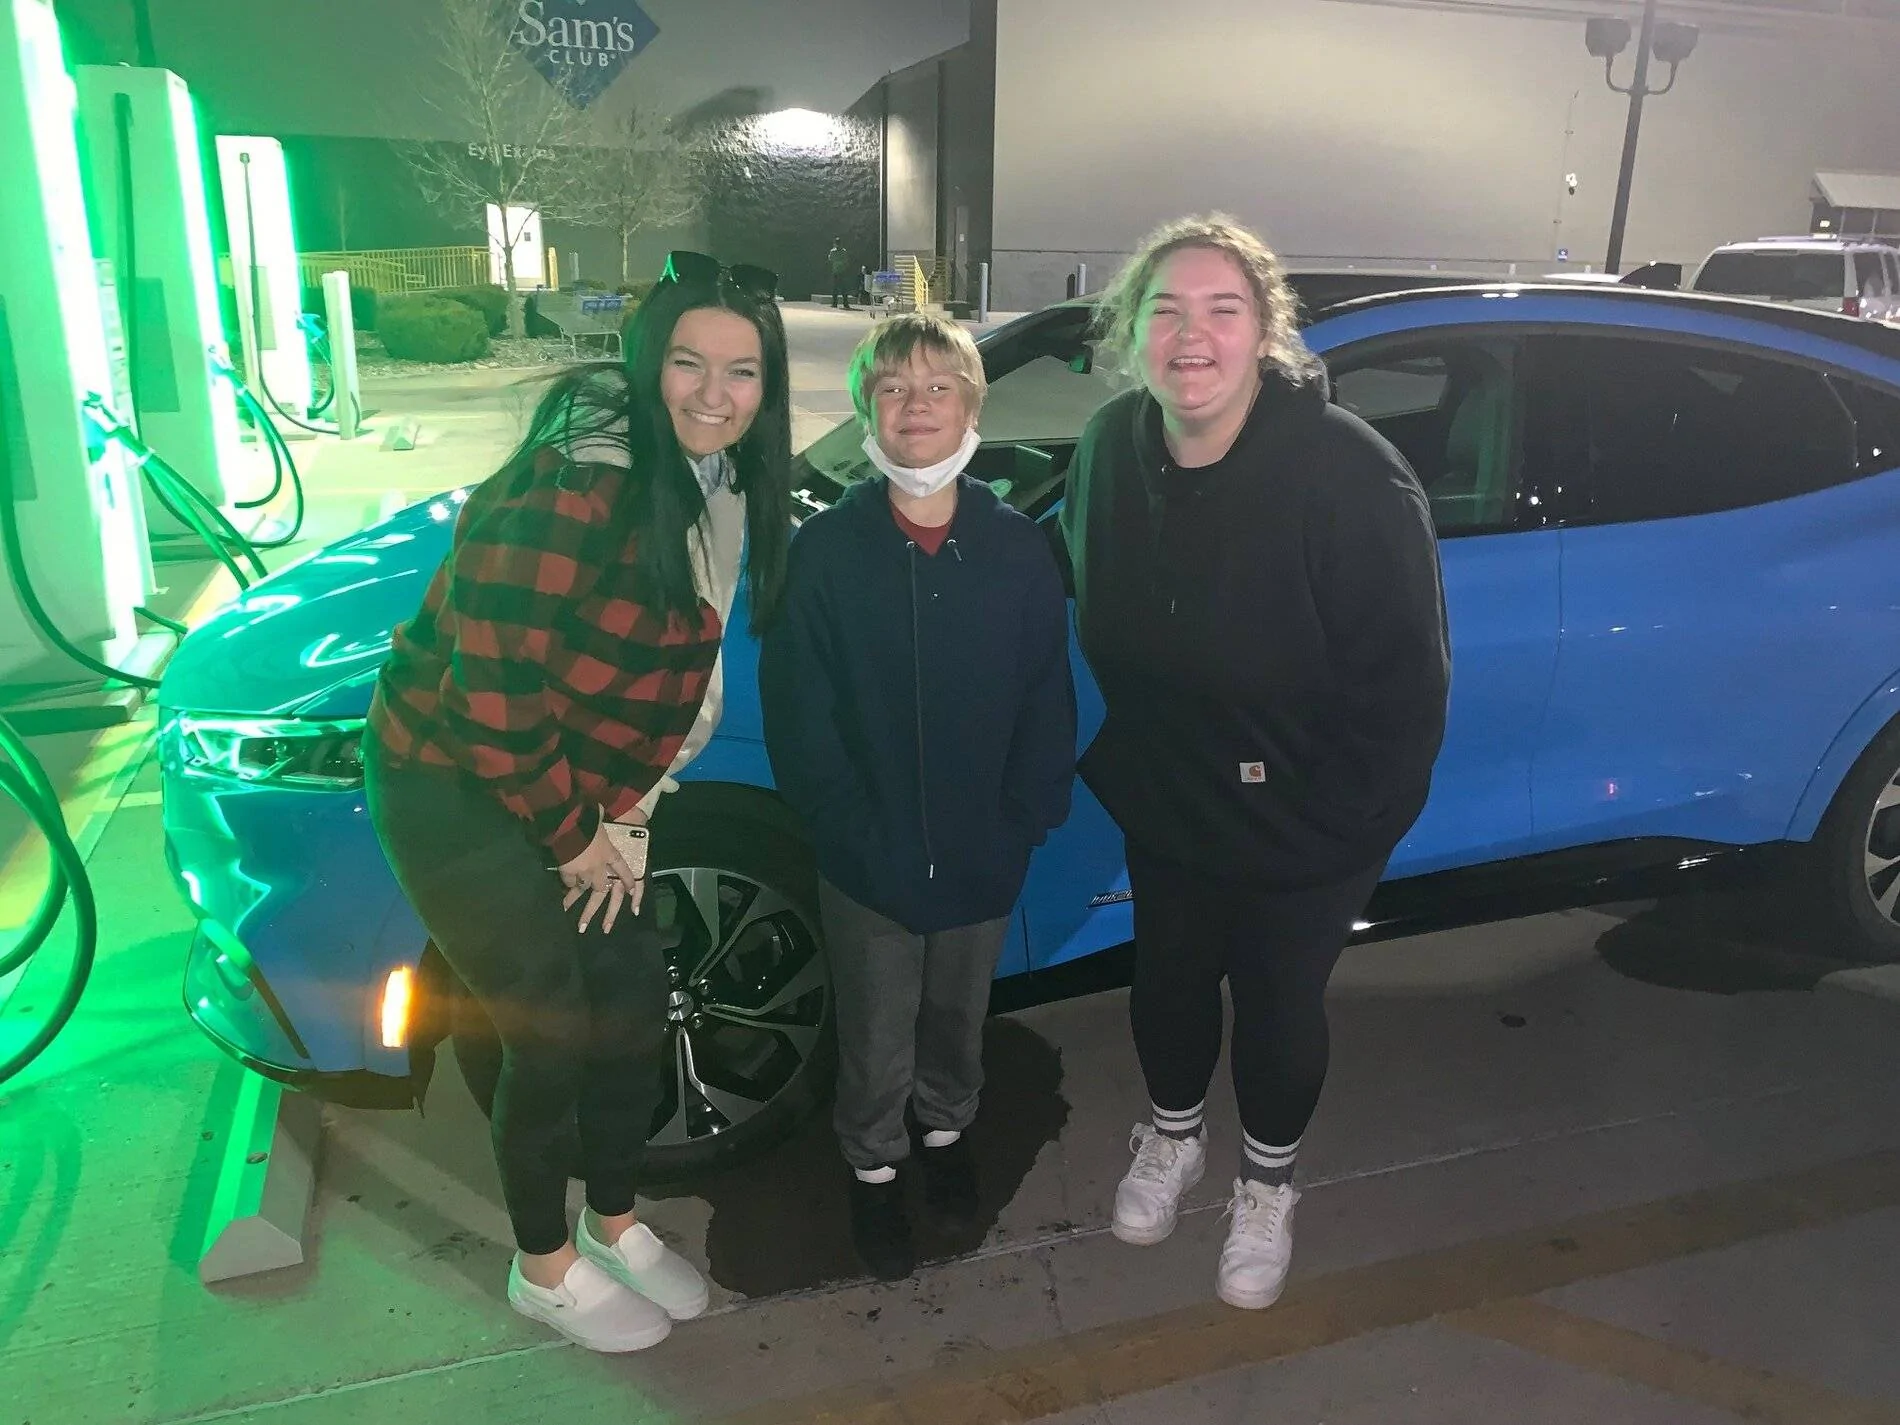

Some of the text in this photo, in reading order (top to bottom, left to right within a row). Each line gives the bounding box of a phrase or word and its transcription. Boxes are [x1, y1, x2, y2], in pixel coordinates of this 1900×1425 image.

[518, 0, 635, 52] Sam's
[548, 49, 609, 67] CLUB
[468, 142, 498, 160] Ey
